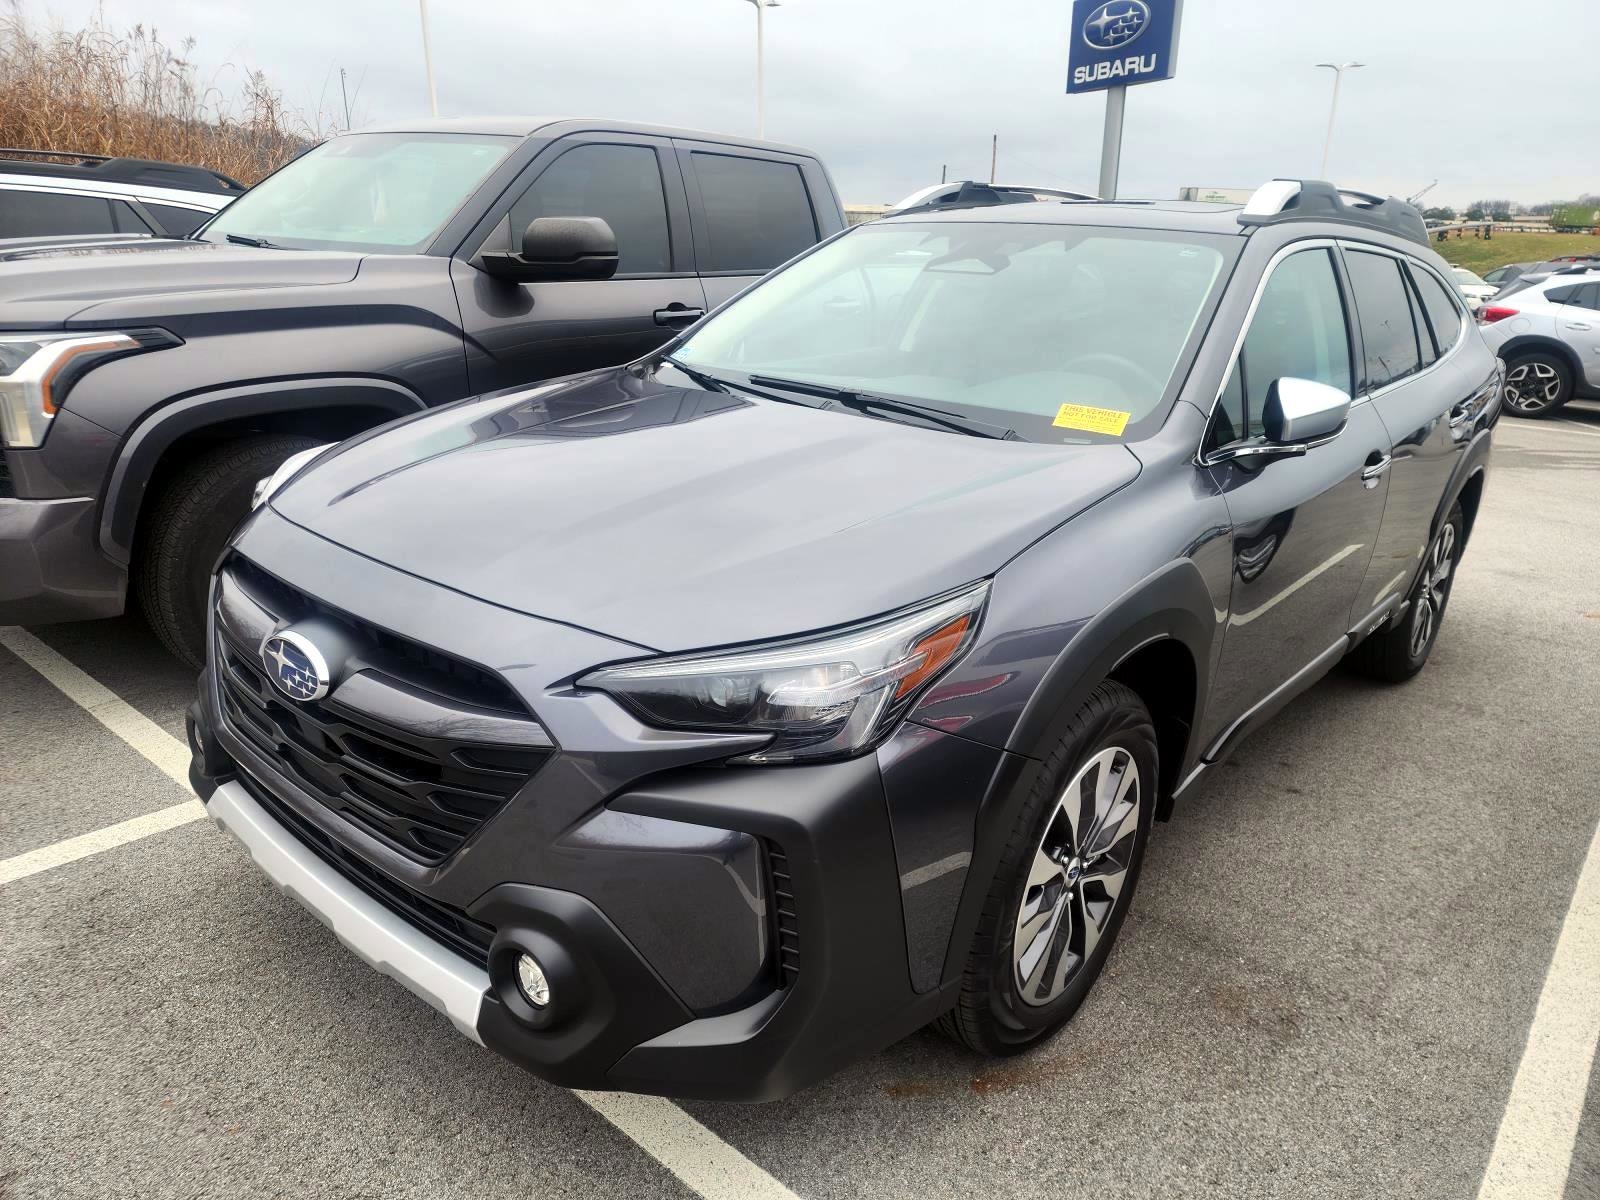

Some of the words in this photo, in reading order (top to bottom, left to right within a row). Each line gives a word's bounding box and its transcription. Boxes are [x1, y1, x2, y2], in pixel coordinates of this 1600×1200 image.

[1074, 54, 1157, 84] SUBARU
[1064, 405, 1085, 413] THIS
[1086, 408, 1123, 419] VEHICLE
[1099, 416, 1120, 424] SALE
